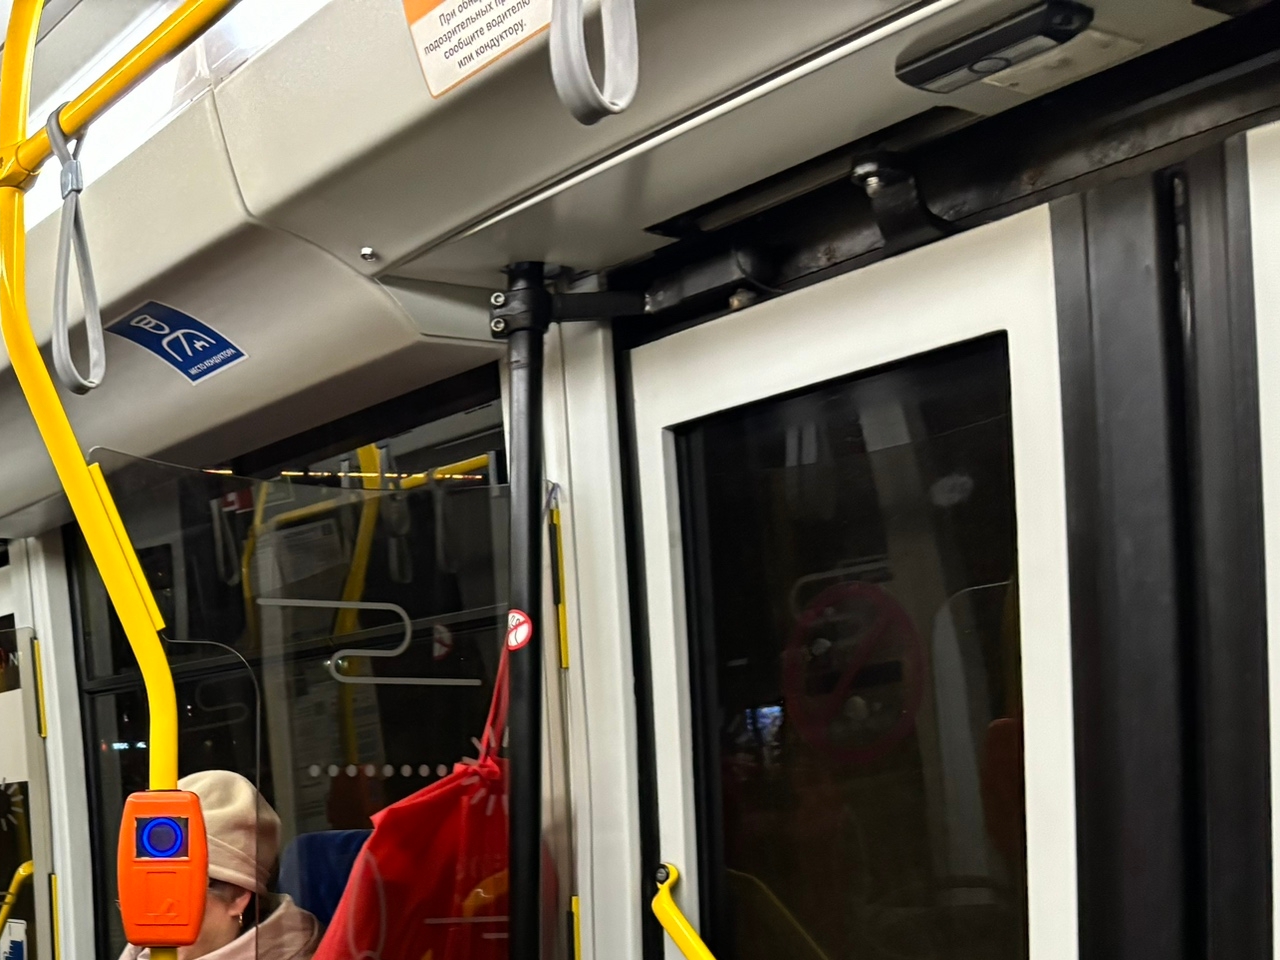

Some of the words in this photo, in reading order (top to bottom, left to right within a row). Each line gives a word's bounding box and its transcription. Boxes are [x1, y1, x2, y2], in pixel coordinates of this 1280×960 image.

[424, 2, 494, 55] подозрительных
[438, 8, 457, 26] При
[444, 27, 485, 59] сообщите
[485, 0, 530, 32] водителю
[457, 52, 475, 69] или
[475, 19, 527, 57] кондуктору.
